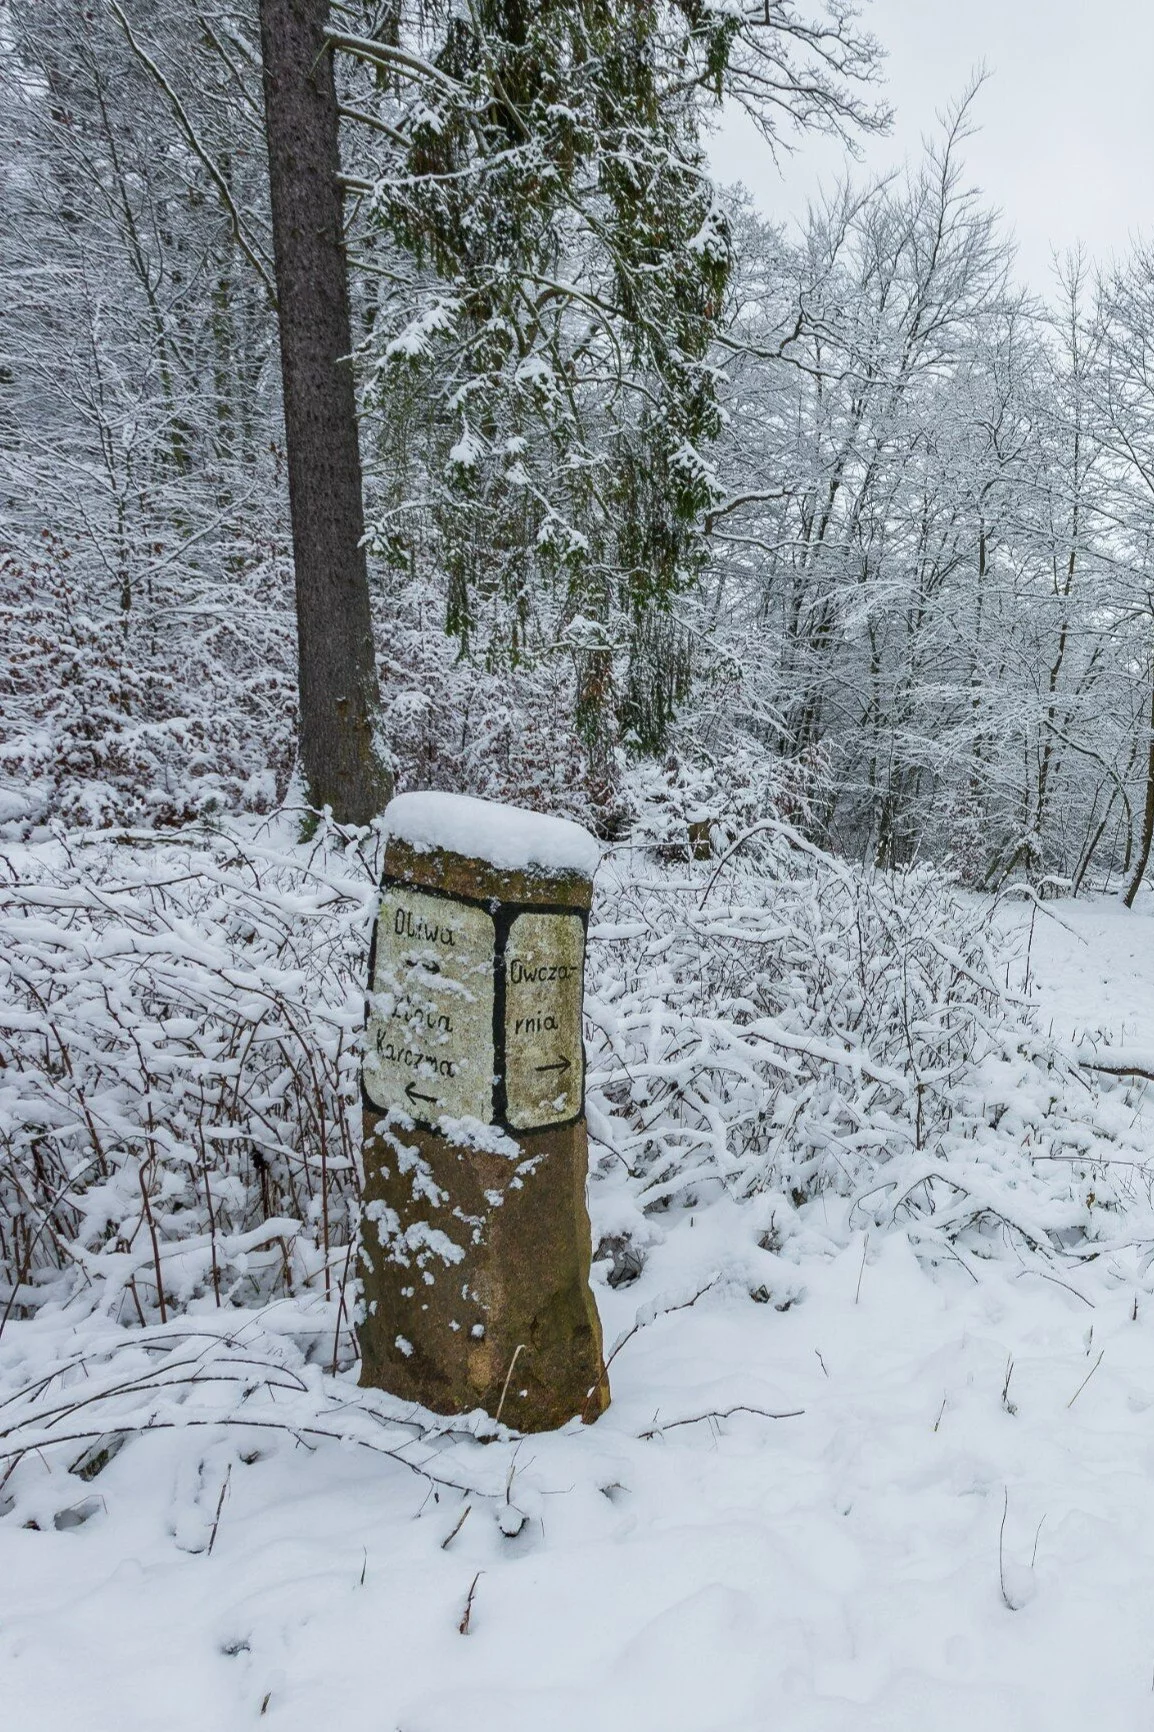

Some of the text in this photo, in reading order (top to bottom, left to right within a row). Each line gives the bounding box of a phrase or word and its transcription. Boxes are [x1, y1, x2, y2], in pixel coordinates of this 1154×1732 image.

[395, 908, 455, 947] Oliwa
[510, 958, 578, 984] Owcza-
[514, 1010, 559, 1035] rnia
